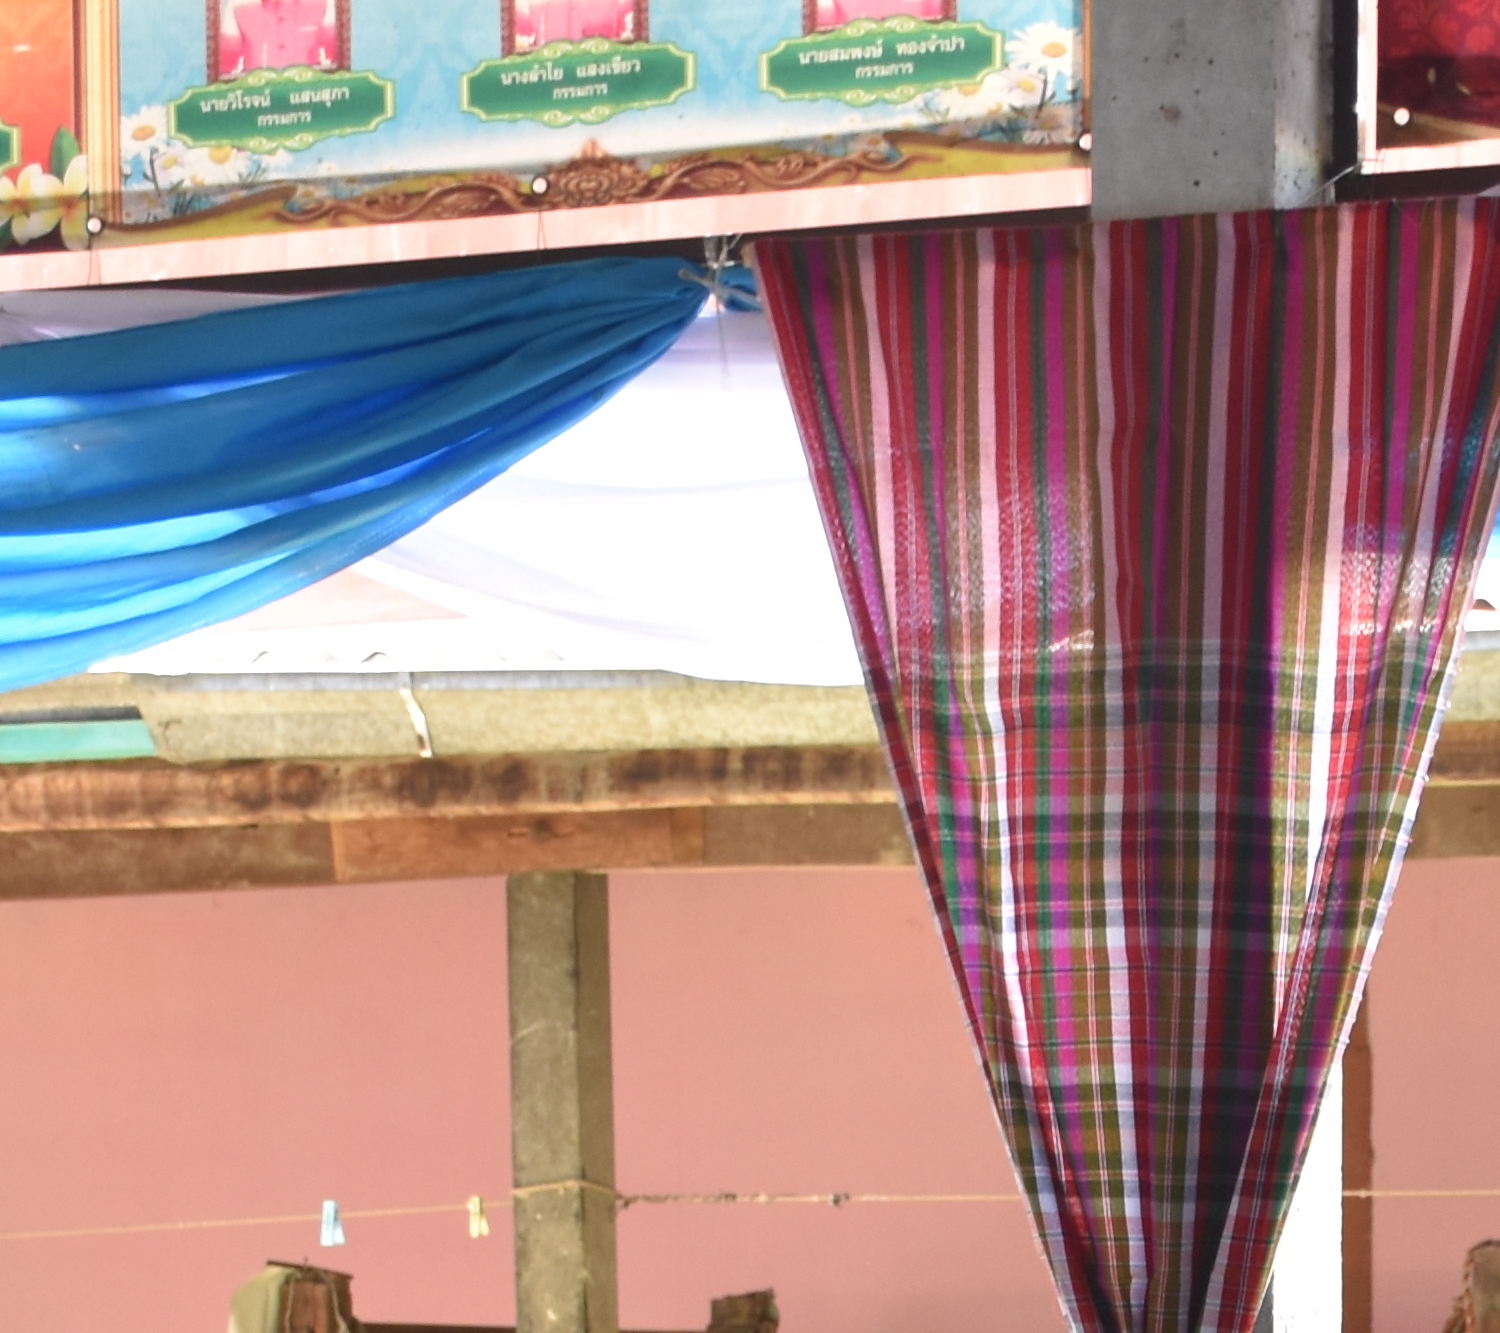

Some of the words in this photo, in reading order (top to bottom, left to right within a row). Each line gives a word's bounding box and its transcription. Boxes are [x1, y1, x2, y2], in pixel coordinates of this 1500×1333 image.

[855, 62, 914, 79] กรรมการ
[553, 83, 609, 100] กรรมการ
[257, 111, 312, 127] กรรมการ
